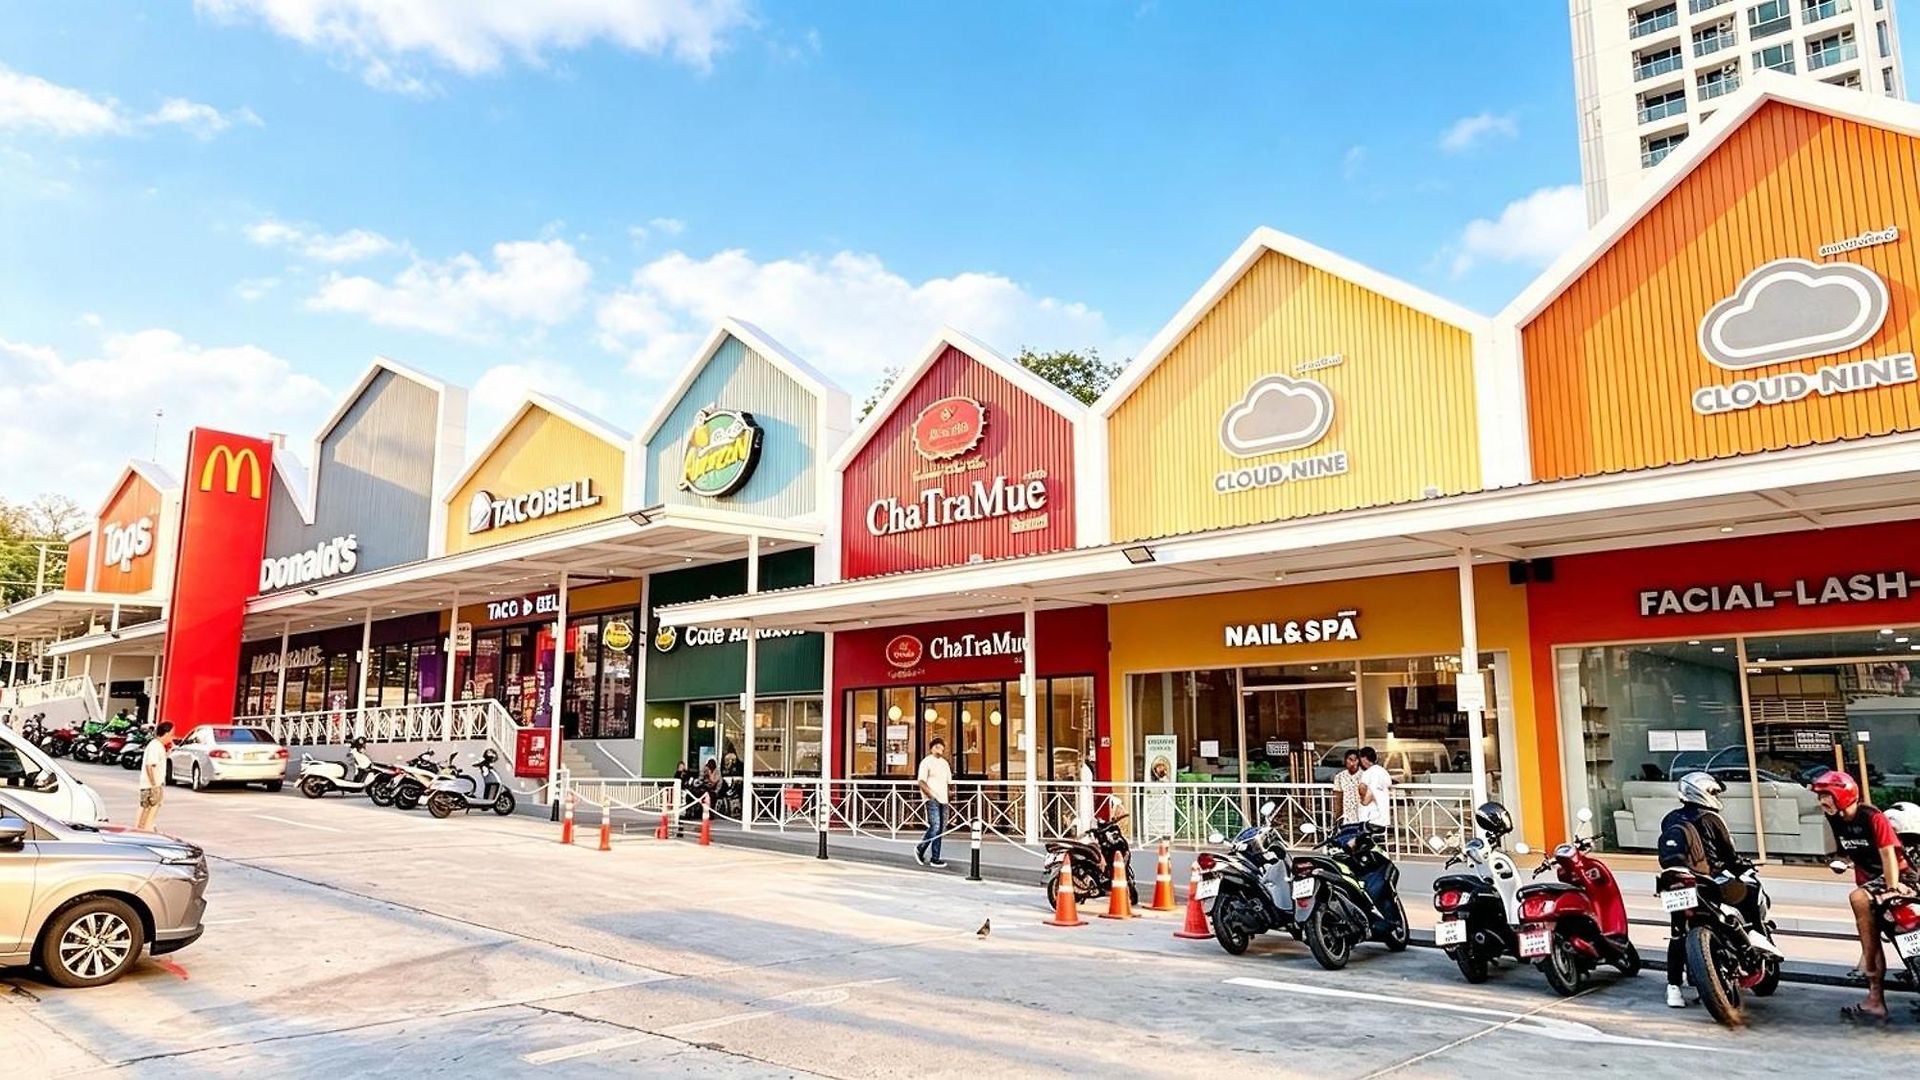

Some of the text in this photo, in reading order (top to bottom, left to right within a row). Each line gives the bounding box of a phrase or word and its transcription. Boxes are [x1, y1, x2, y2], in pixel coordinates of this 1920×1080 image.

[1695, 356, 1914, 410] CLOUD NINE
[1215, 454, 1345, 491] CLOUD NINE
[866, 475, 1047, 537] ChaTraMue
[103, 517, 152, 573] Tops
